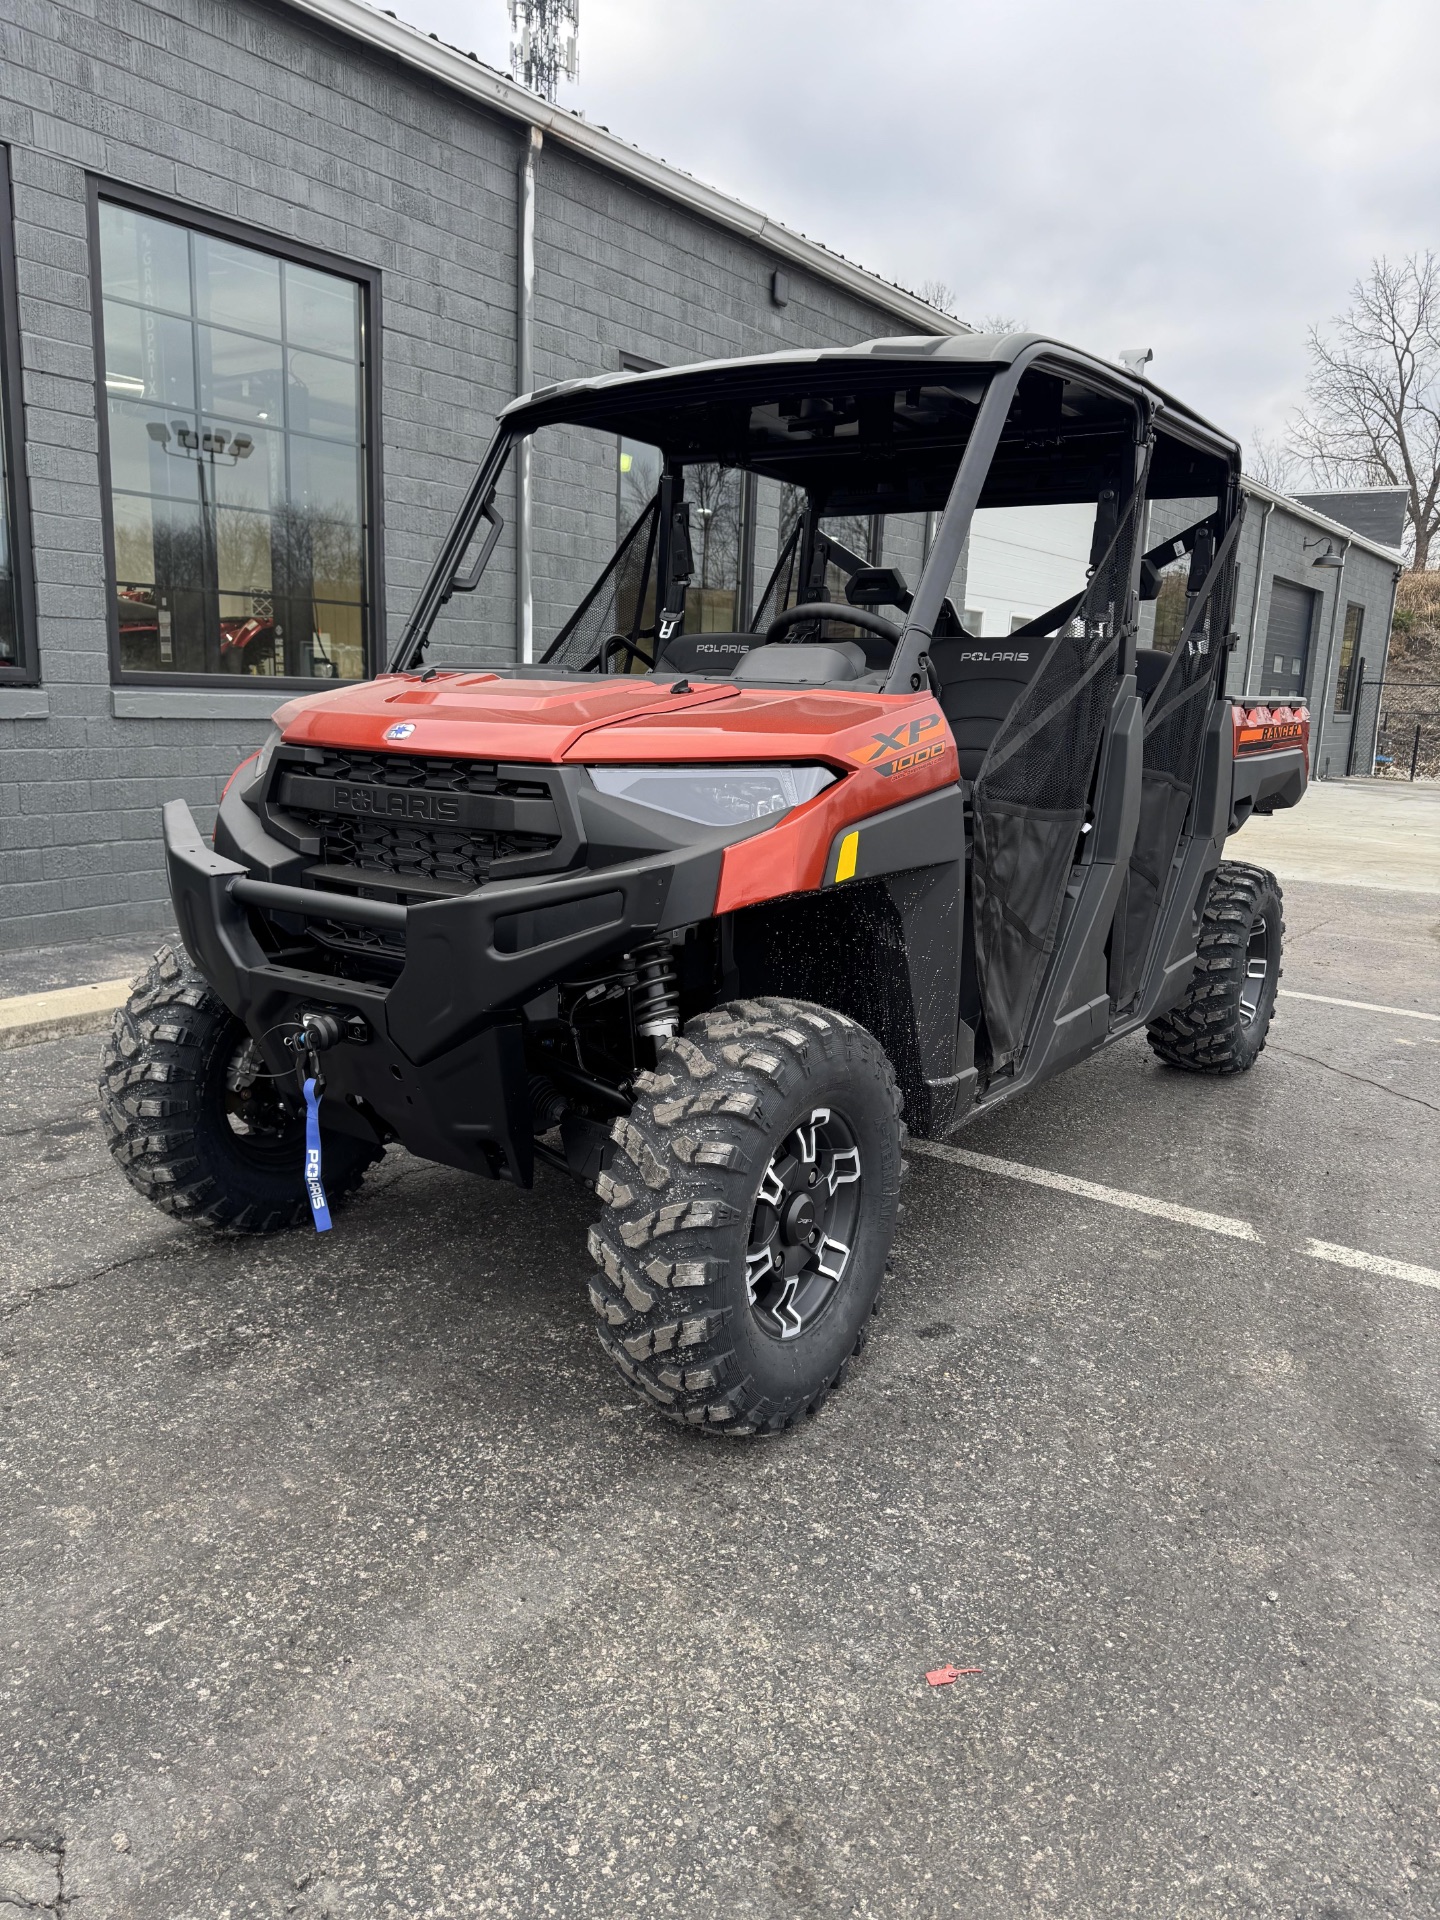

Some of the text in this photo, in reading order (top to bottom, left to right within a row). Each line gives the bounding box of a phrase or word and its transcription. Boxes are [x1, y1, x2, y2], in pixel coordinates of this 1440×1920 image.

[696, 644, 750, 655] POLARIS
[960, 651, 1030, 662] POLARIS
[868, 714, 940, 760] XP
[1261, 724, 1299, 741] RANGER
[891, 742, 945, 773] 1000
[333, 787, 459, 821] POLARIS
[307, 1150, 325, 1209] POLARIS
